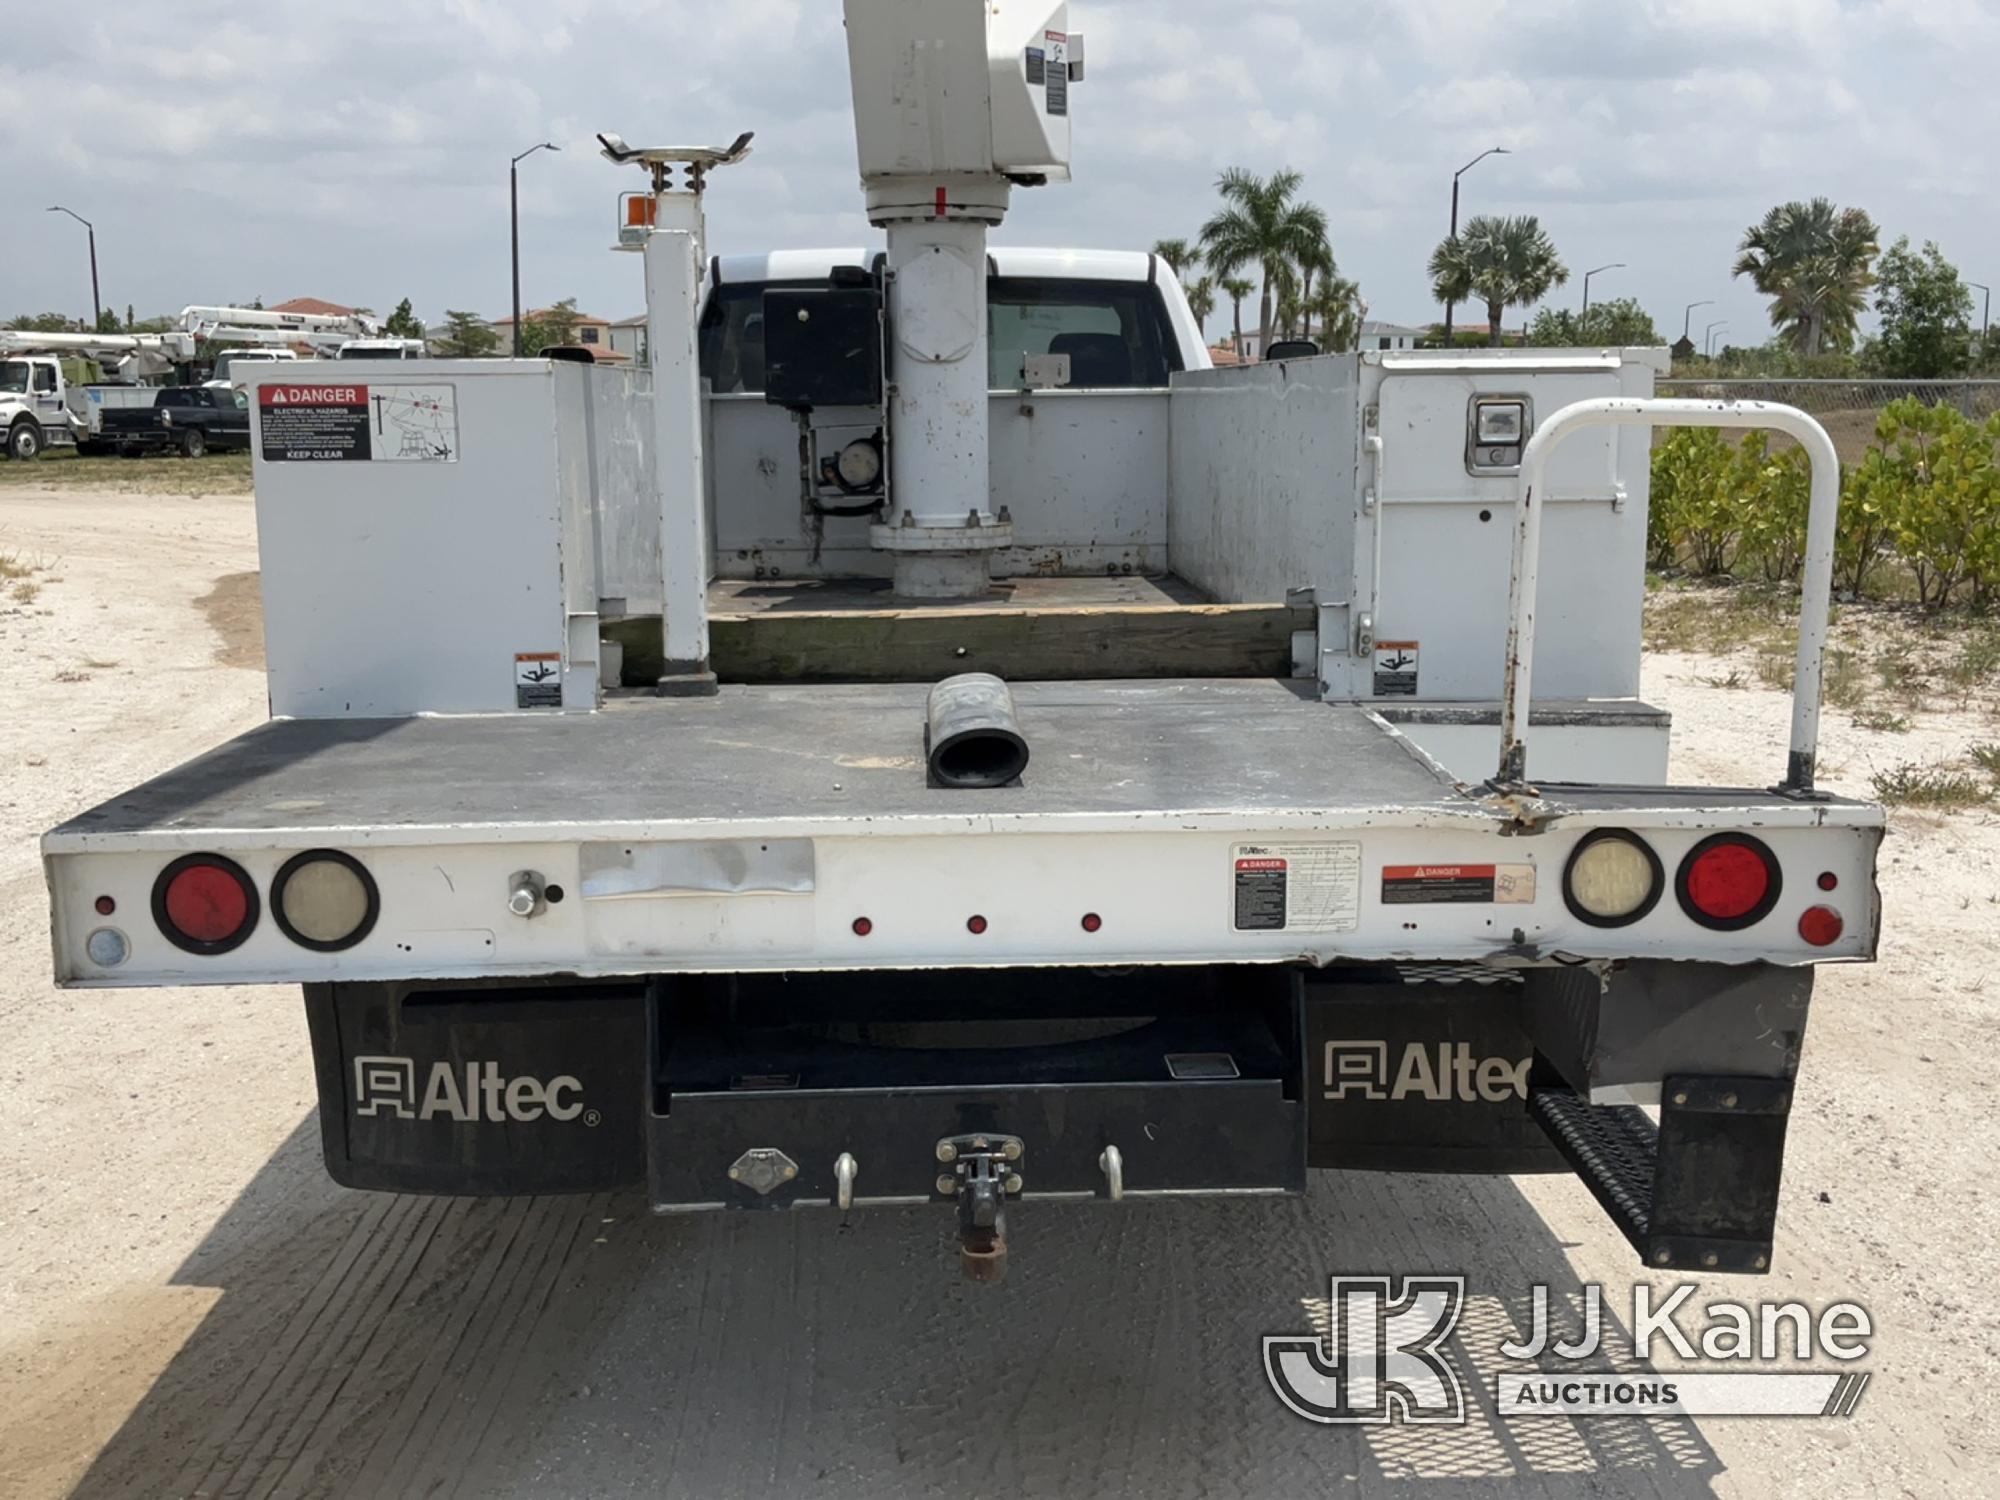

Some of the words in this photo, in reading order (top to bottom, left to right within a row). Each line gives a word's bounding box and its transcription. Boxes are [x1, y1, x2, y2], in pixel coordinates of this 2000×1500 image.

[289, 388, 357, 402] DANGER
[286, 451, 311, 459] KEEP
[312, 451, 344, 459] CLEAR
[1249, 860, 1281, 868] DANGER
[1426, 867, 1461, 876] DANGER
